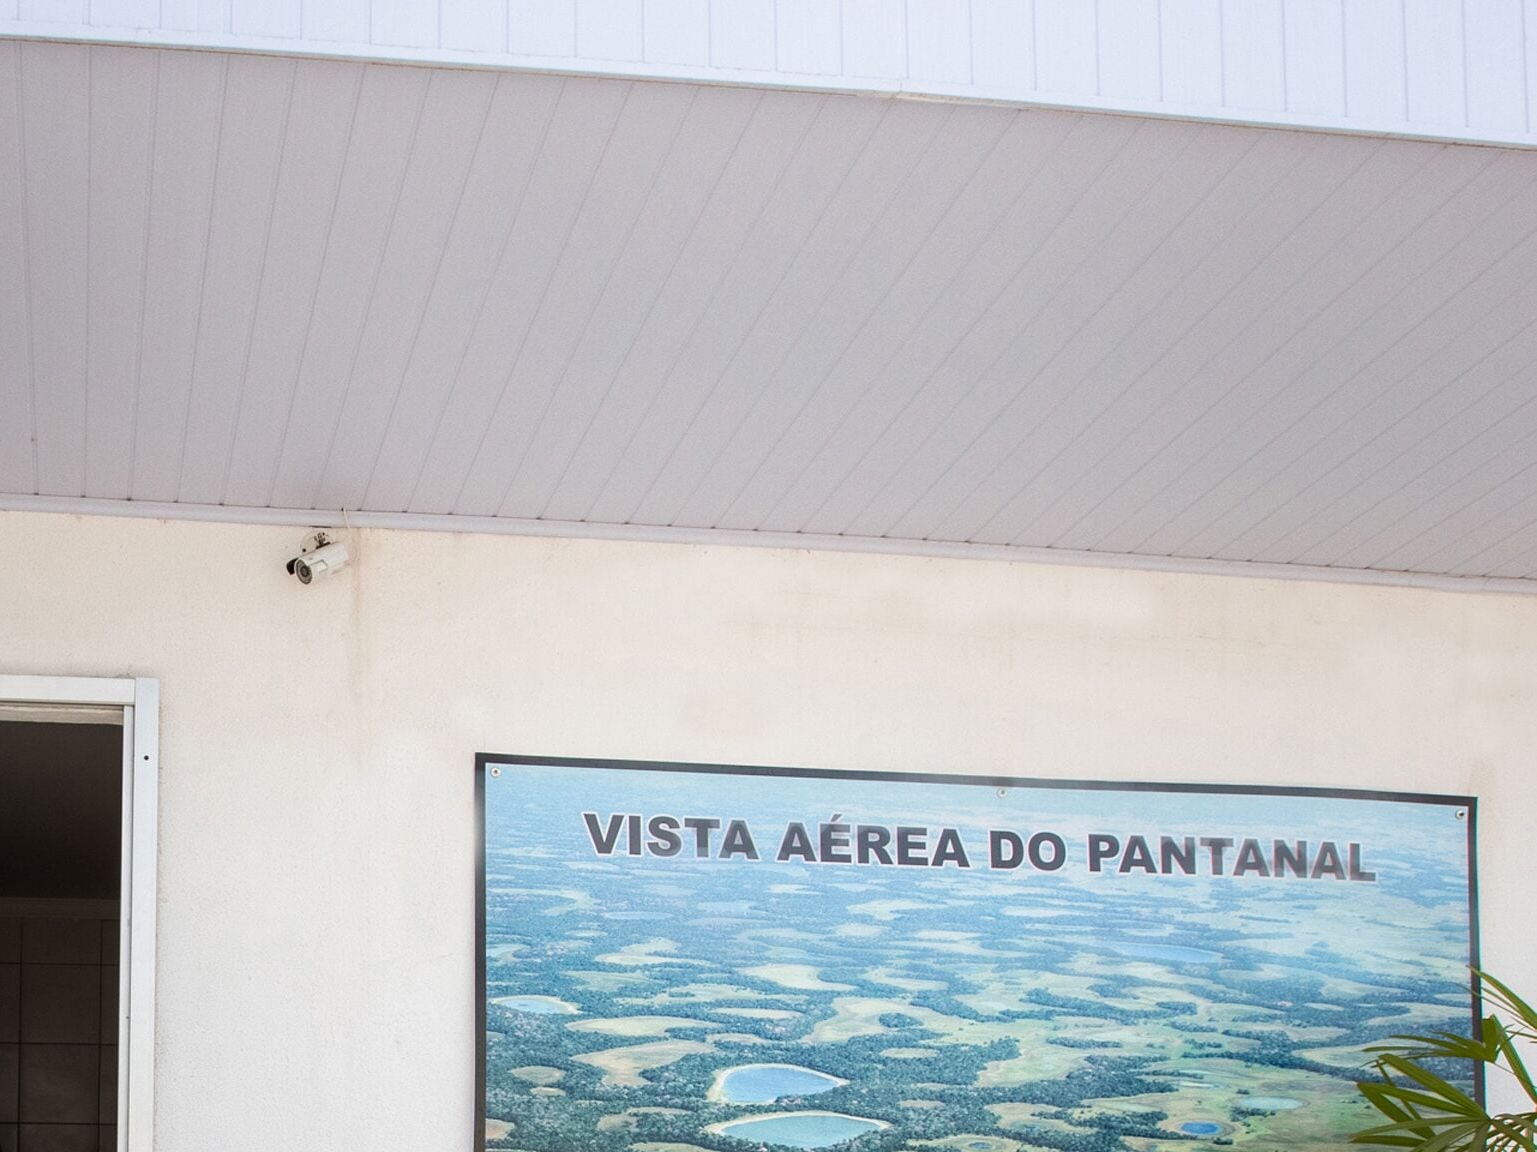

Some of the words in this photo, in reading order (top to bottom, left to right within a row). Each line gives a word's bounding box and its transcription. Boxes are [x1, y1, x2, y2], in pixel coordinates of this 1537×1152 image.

[583, 812, 759, 861] VISTA
[777, 813, 970, 868] AÉREA
[989, 830, 1066, 872] DO
[1087, 834, 1377, 882] PANTANAL
